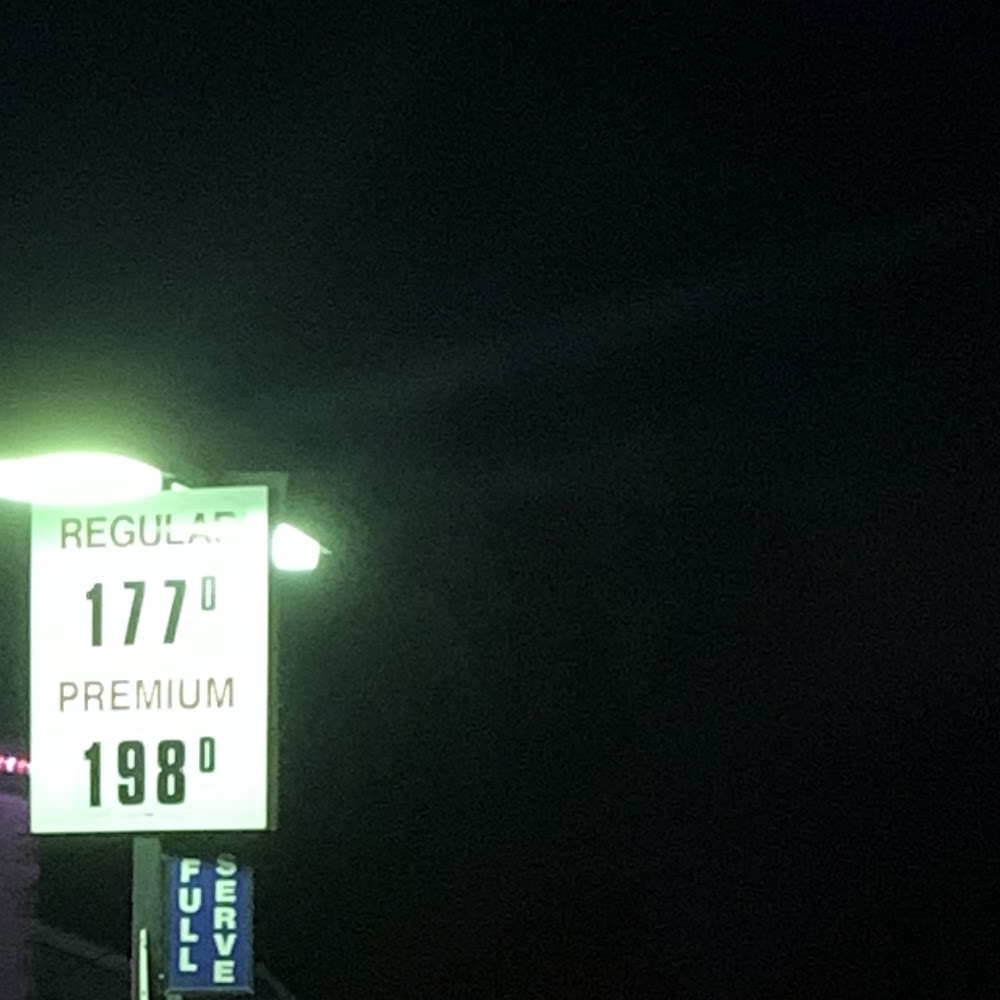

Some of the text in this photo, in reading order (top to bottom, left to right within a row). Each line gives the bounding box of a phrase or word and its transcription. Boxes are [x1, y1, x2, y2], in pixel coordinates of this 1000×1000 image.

[59, 677, 234, 712] PREMIUM
[178, 853, 238, 983] FULL SERVE
